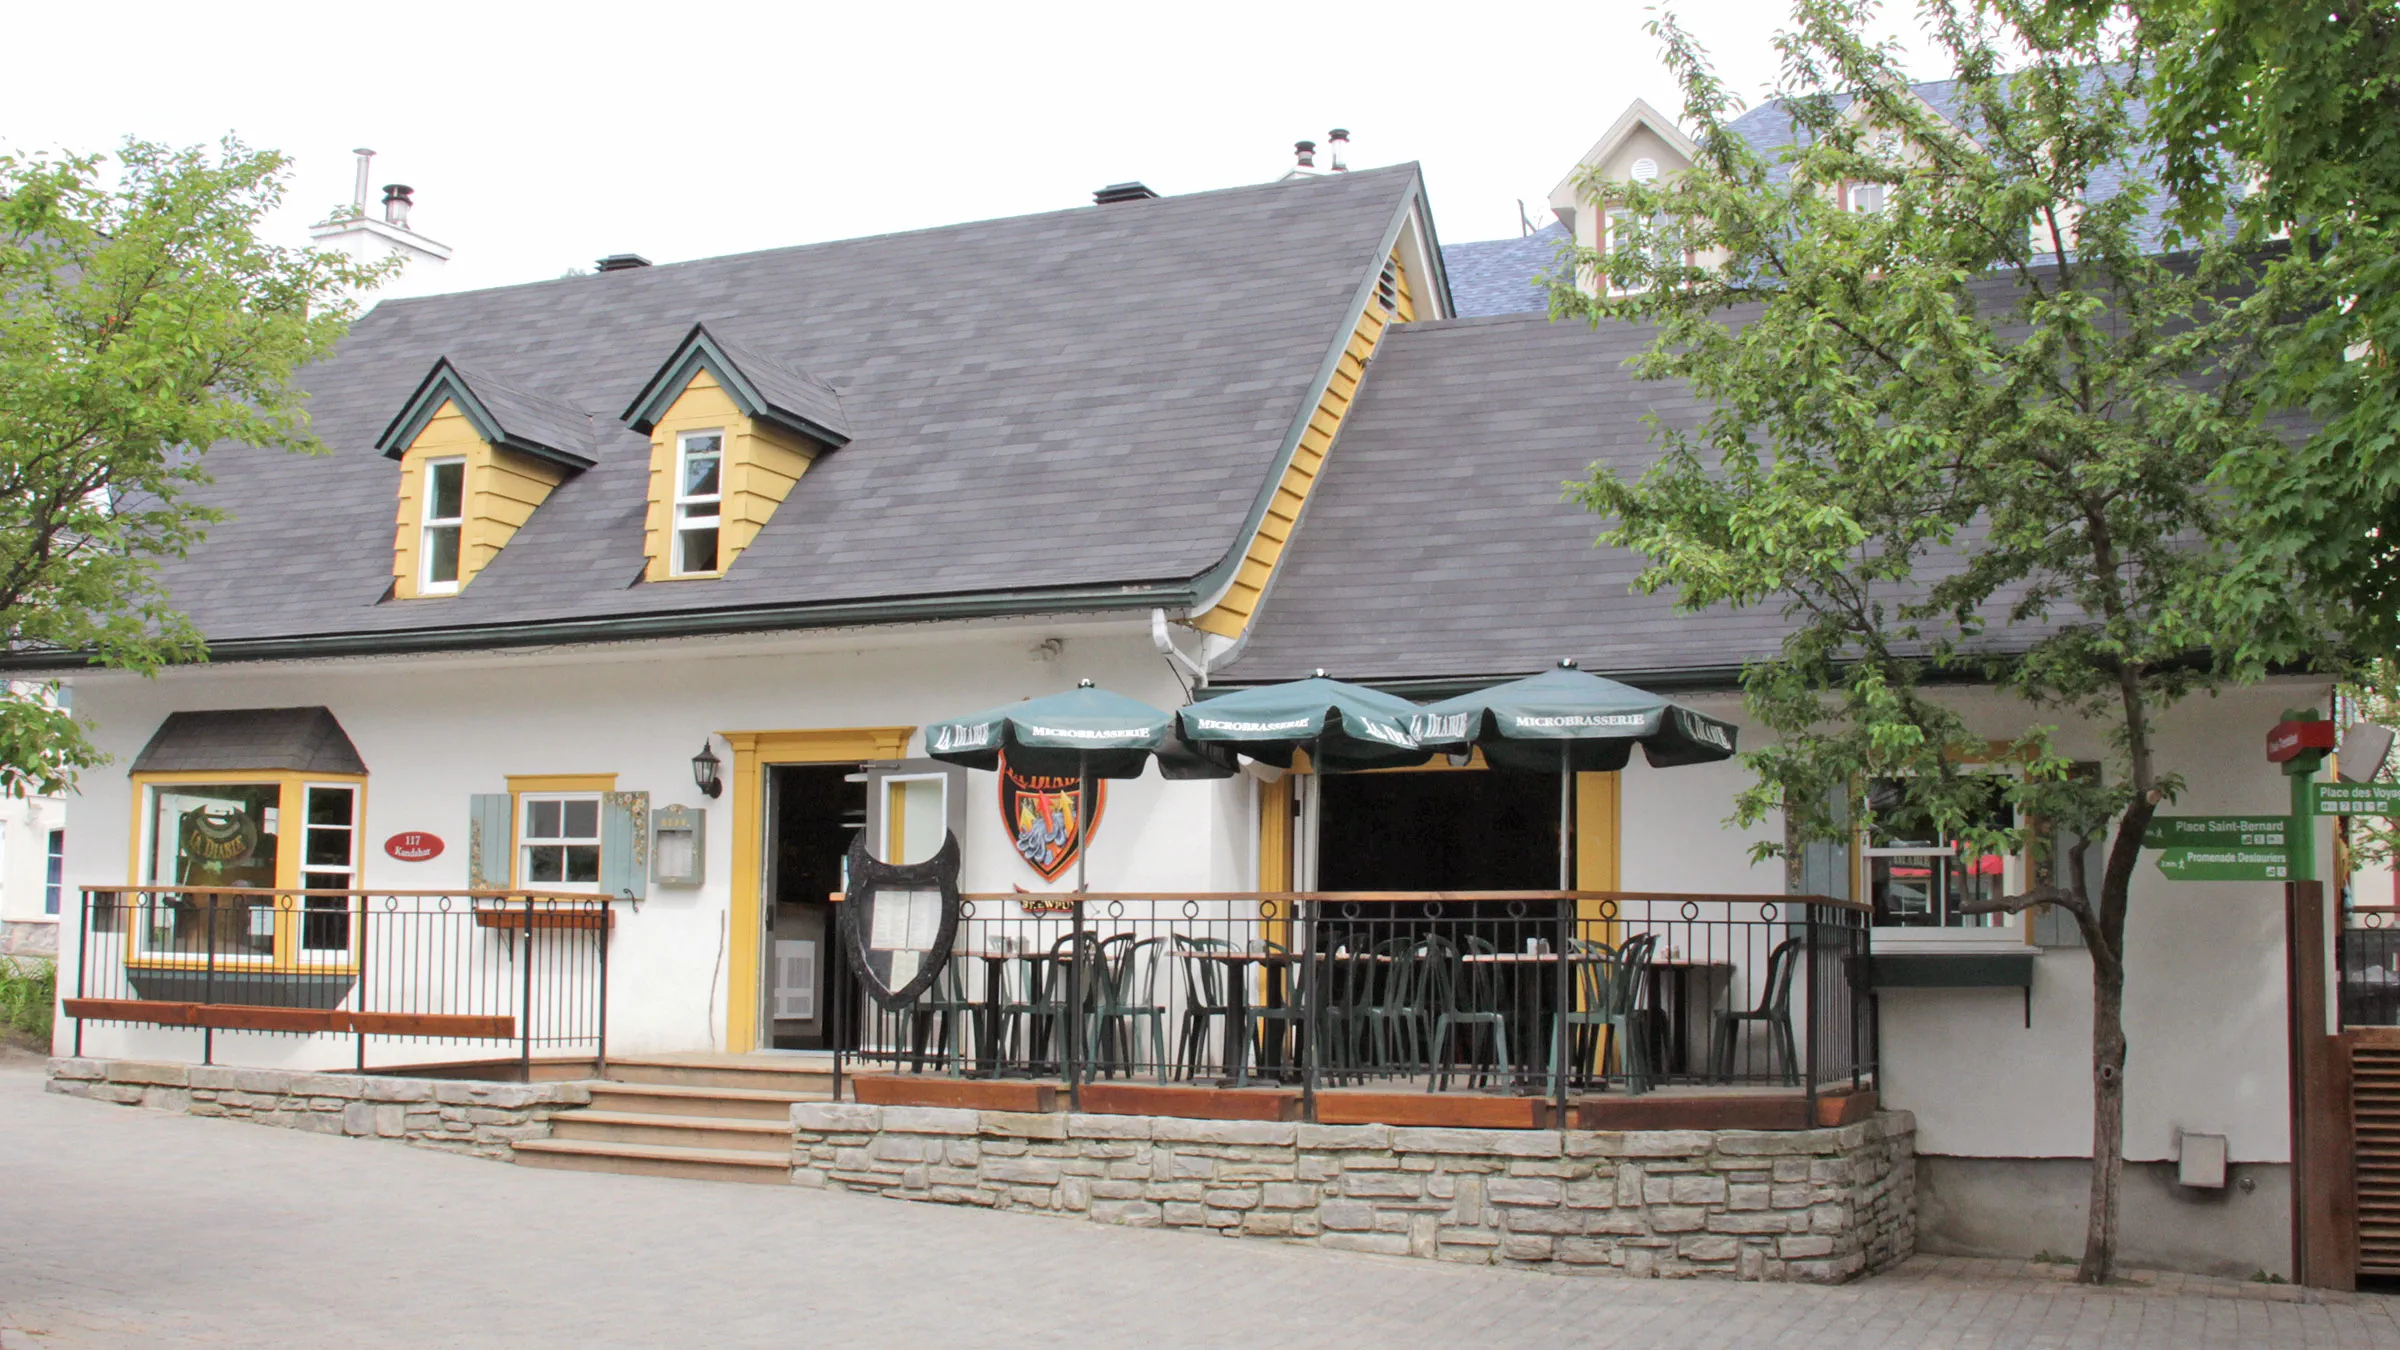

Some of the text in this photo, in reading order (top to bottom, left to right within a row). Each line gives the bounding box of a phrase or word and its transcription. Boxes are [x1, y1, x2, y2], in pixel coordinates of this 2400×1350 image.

[1516, 713, 1645, 727] MICROBRASSERIE
[1032, 726, 1150, 739] MICROBRASSERIE
[2320, 787, 2400, 801] Place des Voya
[2176, 820, 2284, 832] Place Saint-Bernard
